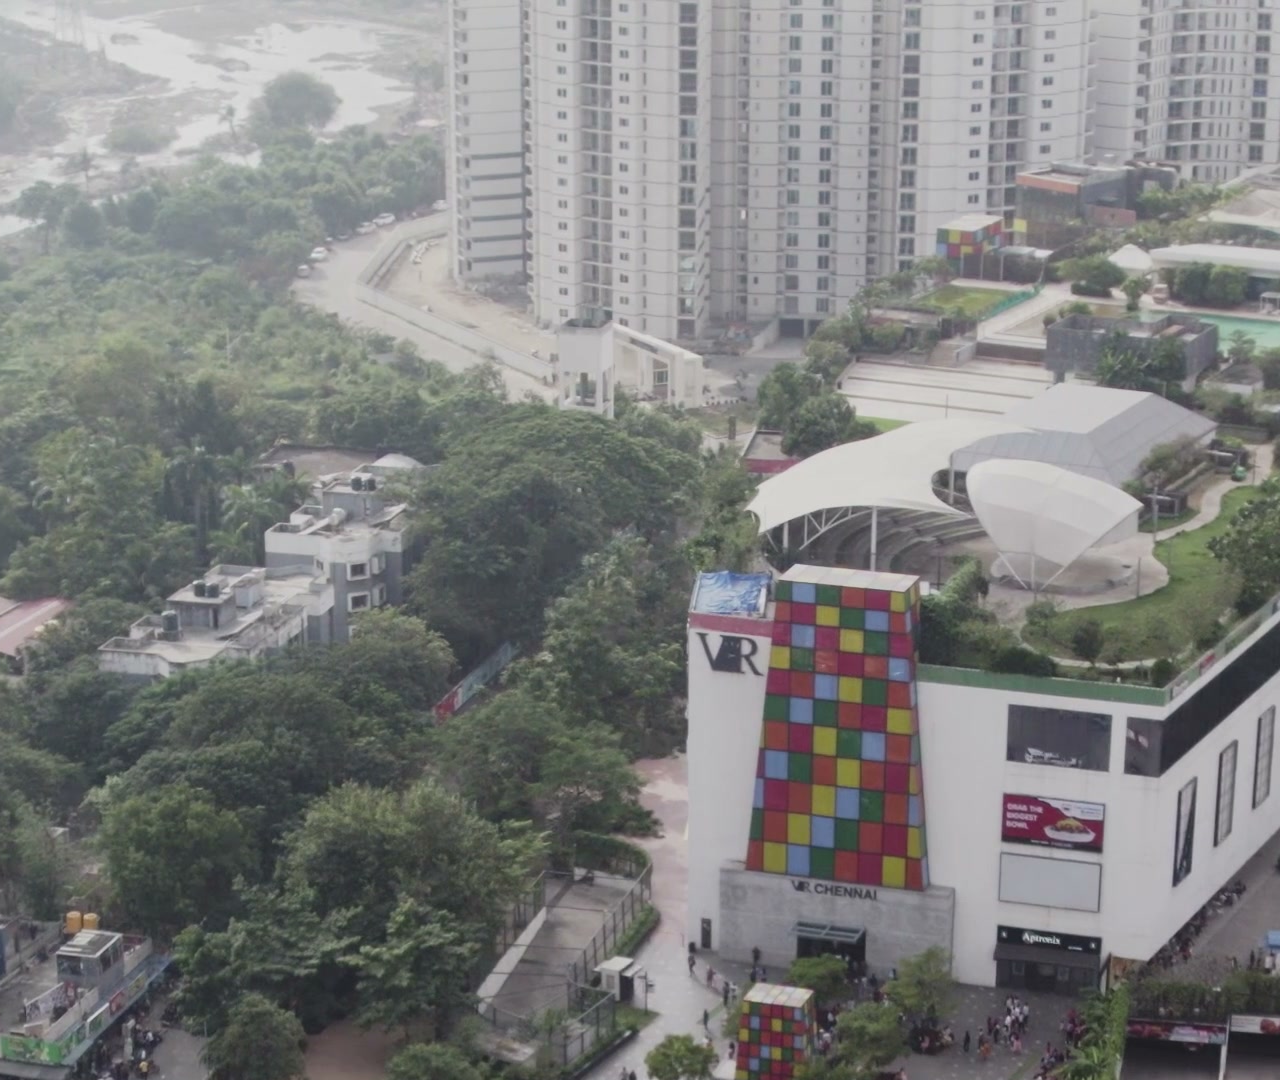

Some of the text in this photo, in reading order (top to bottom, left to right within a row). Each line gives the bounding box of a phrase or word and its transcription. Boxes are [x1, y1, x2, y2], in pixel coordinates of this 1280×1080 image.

[696, 632, 764, 676] VR
[1029, 805, 1043, 814] THE
[1006, 812, 1037, 821] BIGGEST
[1006, 820, 1029, 829] BOWL
[814, 883, 877, 900] CHENNAI
[1022, 931, 1061, 945] Aptronix
